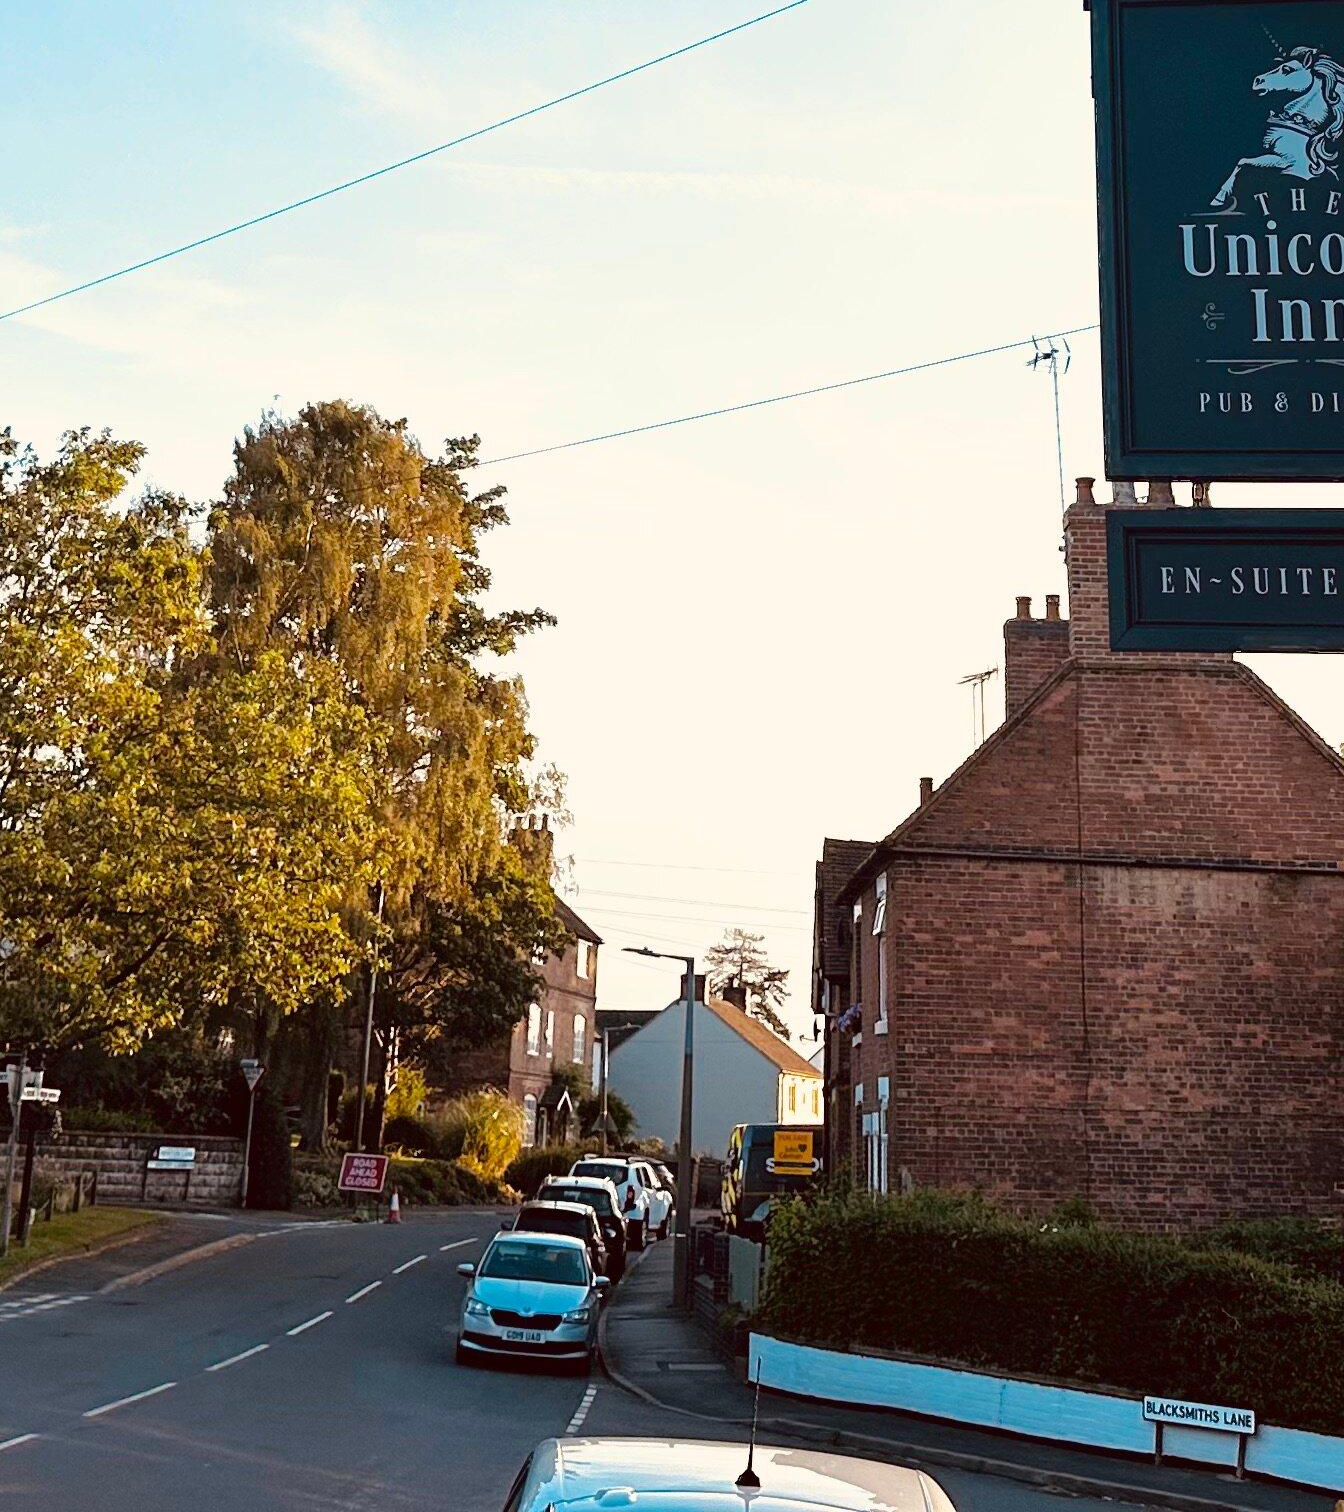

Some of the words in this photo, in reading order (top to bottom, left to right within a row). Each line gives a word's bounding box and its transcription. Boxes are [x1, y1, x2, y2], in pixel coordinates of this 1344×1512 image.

[1253, 188, 1342, 216] THE
[1199, 392, 1254, 413] PUB
[1274, 391, 1289, 413] &
[353, 1158, 377, 1167] ROAD
[349, 1168, 377, 1177] AHEAD
[345, 1176, 377, 1187] CLOSED
[1146, 1400, 1220, 1424] BLACKSMITHS
[1223, 1412, 1252, 1428] LANE
